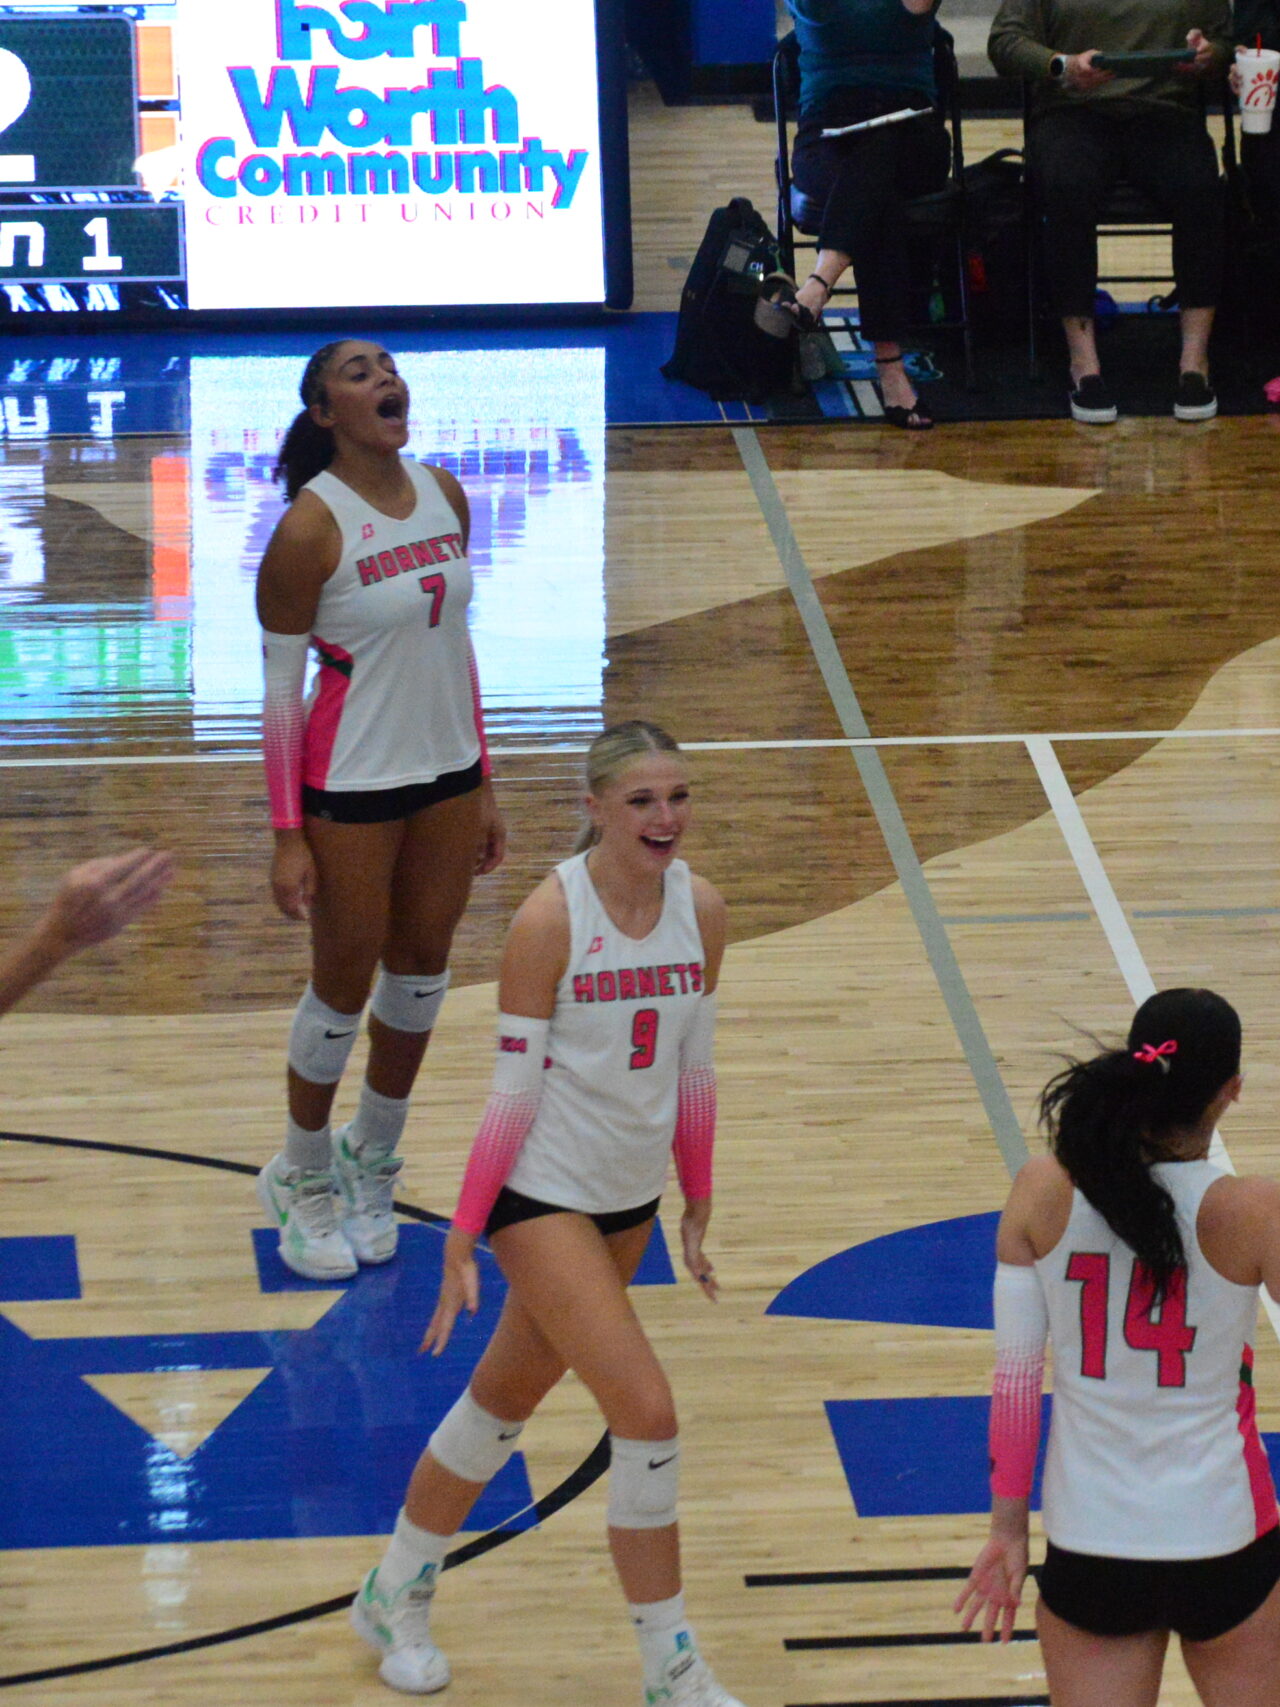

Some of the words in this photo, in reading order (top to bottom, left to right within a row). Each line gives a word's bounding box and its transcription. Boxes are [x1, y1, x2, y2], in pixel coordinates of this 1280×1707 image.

[227, 57, 519, 148] Worth
[196, 136, 589, 209] Community
[205, 202, 373, 226] CREDIT
[400, 200, 545, 223] UNION
[82, 217, 122, 271] 1
[418, 572, 447, 629] 7
[573, 962, 704, 1003] HORNETS
[629, 1007, 659, 1071] 9
[1064, 1251, 1197, 1388] 14
